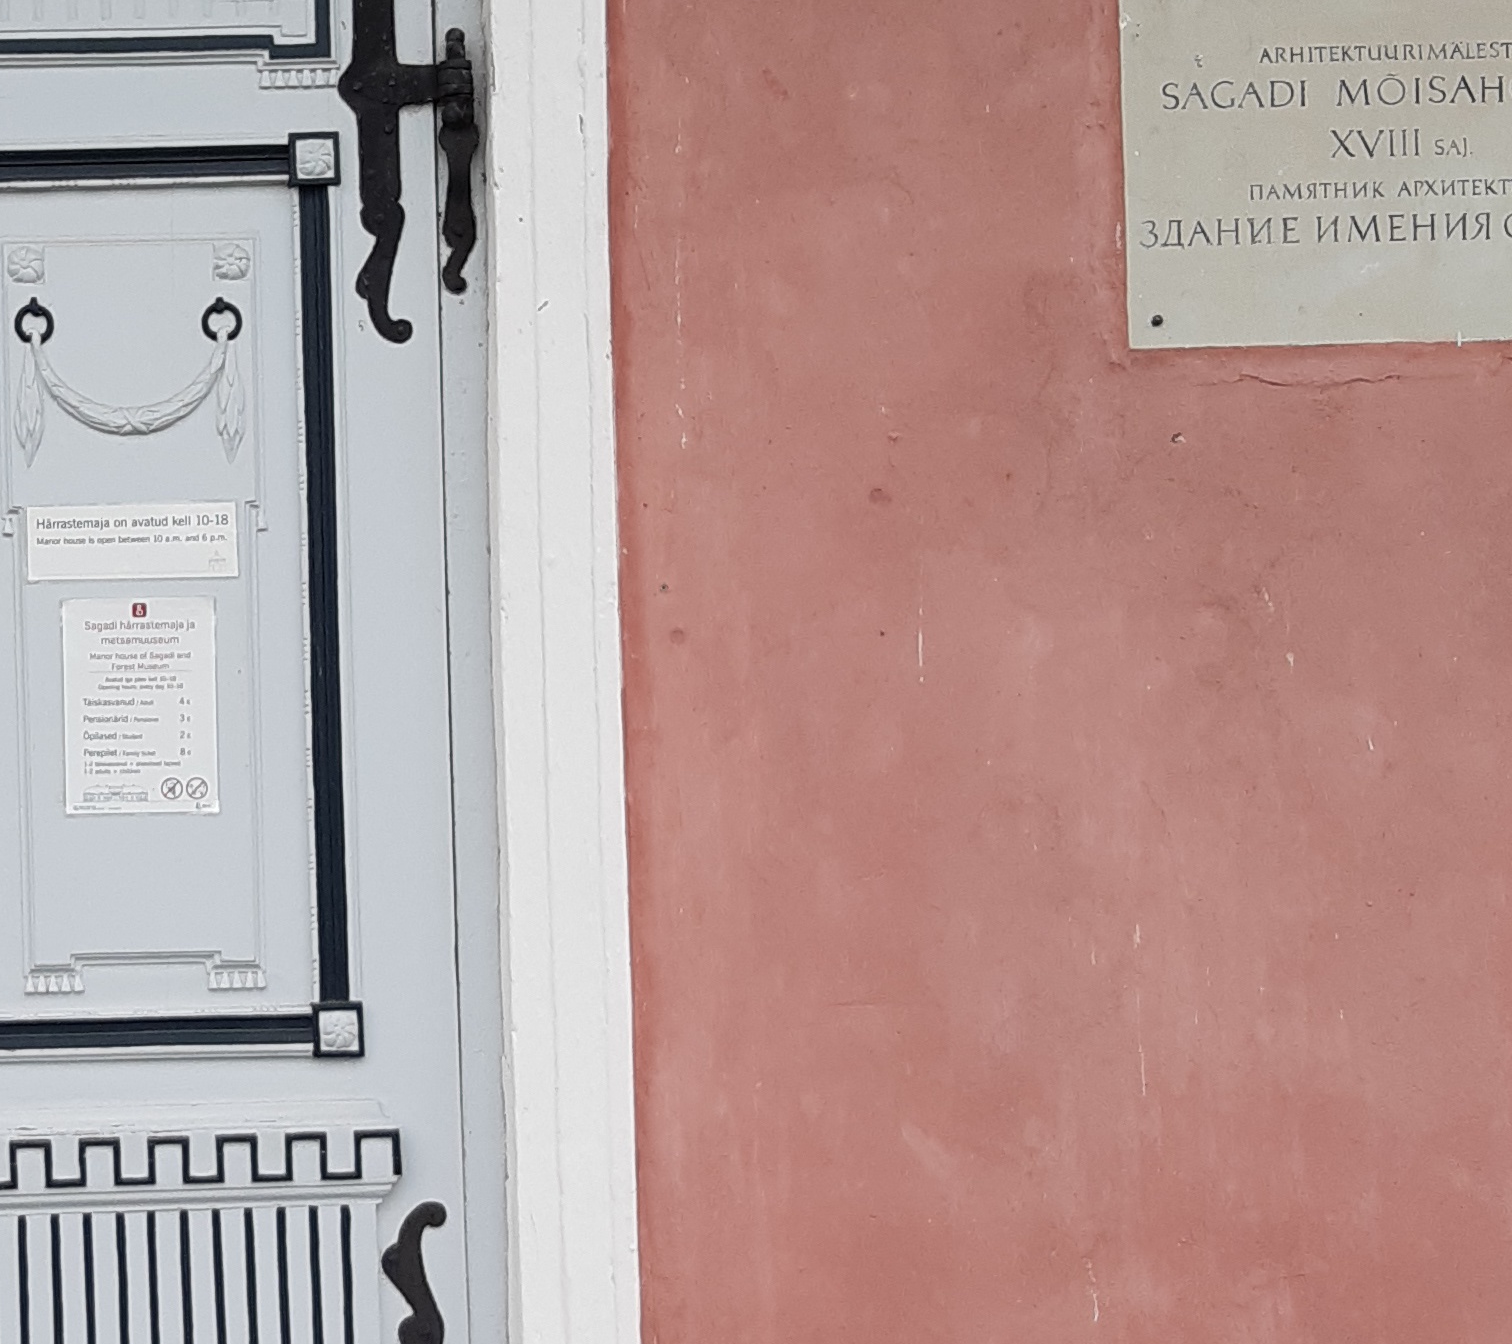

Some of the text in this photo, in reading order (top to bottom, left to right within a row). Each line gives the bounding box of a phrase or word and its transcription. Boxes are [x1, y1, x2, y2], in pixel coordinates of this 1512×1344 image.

[1161, 73, 1504, 110] SAGADI MÕISAH
[1330, 129, 1473, 159] XVIII SAJ.
[1249, 181, 1385, 201] ПАМЯТНИК
[1139, 217, 1300, 249] ЗДАНИЕ
[1316, 212, 1491, 243] ИМЕНИЯ
[113, 518, 128, 528] on
[131, 516, 169, 527] avatud
[172, 515, 191, 526] kell
[196, 514, 229, 526] 10-18
[36, 537, 61, 545] Manor
[63, 536, 86, 544] house
[88, 535, 95, 544] is
[97, 537, 116, 545] open
[118, 535, 150, 544] between
[153, 534, 163, 543] 10
[185, 534, 199, 542] and
[202, 533, 208, 541] 6
[84, 620, 117, 632] Sagadi
[186, 619, 196, 631] ja
[149, 651, 174, 661] Sagadi
[111, 663, 135, 671] Forest
[179, 697, 185, 705] 4
[179, 714, 185, 722] 3
[179, 730, 185, 739] 2
[179, 747, 185, 755] 8
